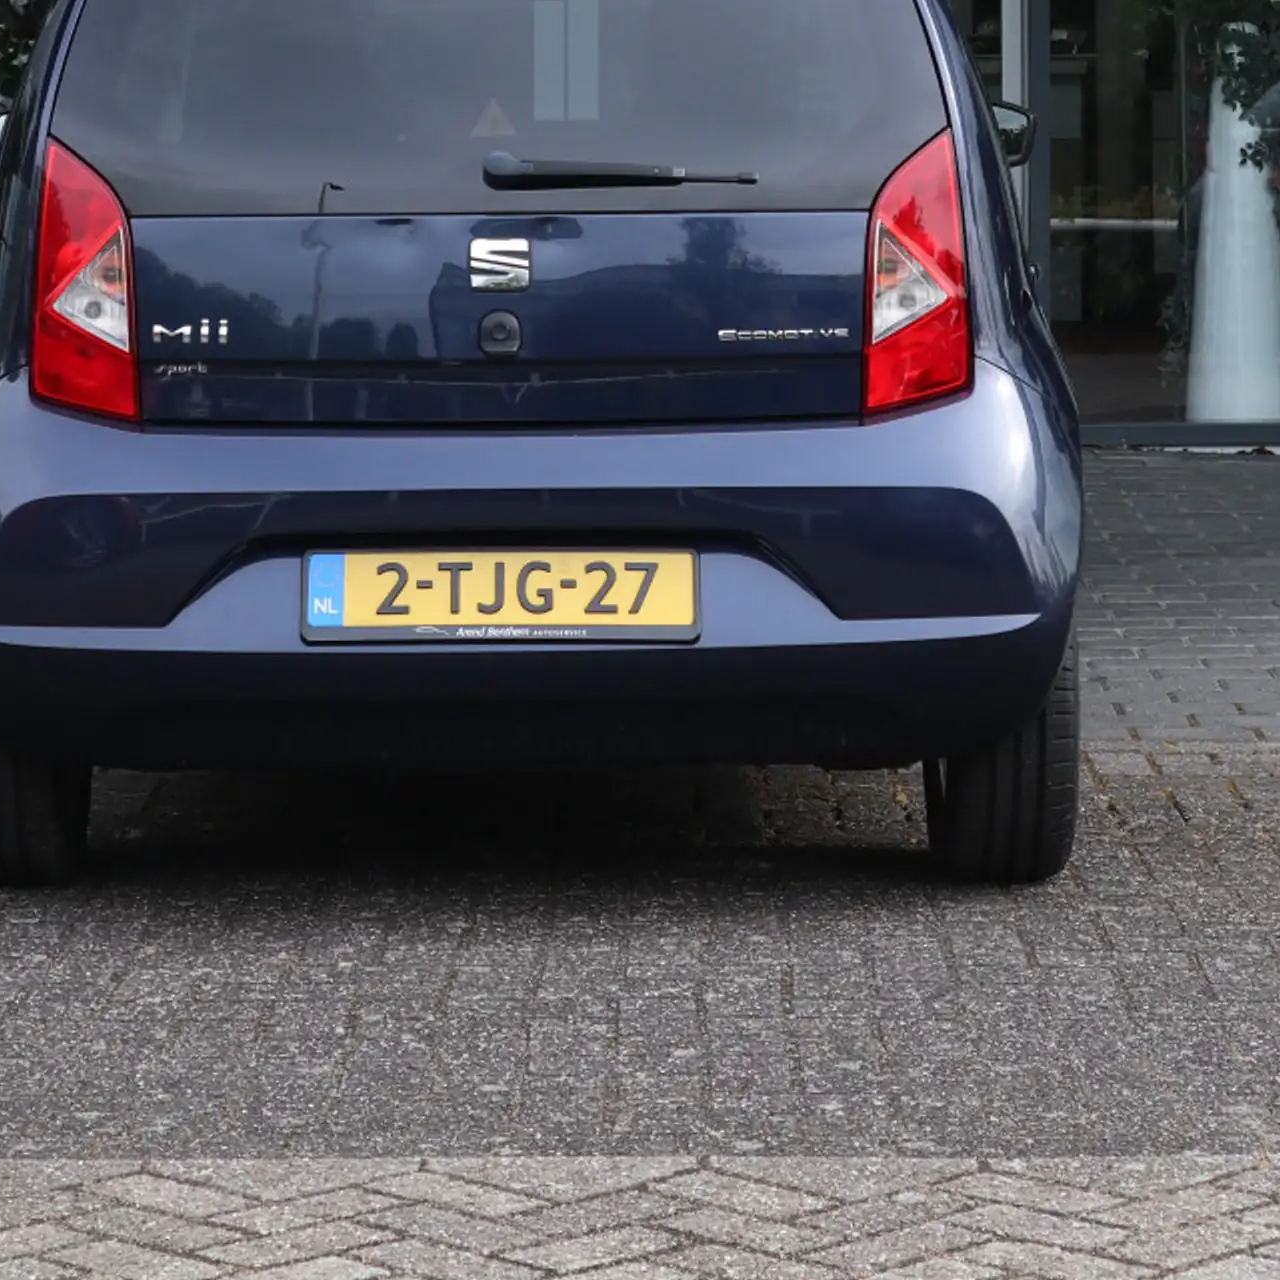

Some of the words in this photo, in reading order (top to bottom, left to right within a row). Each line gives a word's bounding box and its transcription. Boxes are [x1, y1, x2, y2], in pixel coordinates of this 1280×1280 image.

[152, 317, 228, 344] Mii
[376, 561, 659, 615] 2-TJG-27
[313, 596, 339, 615] NL
[455, 626, 486, 638] Arend
